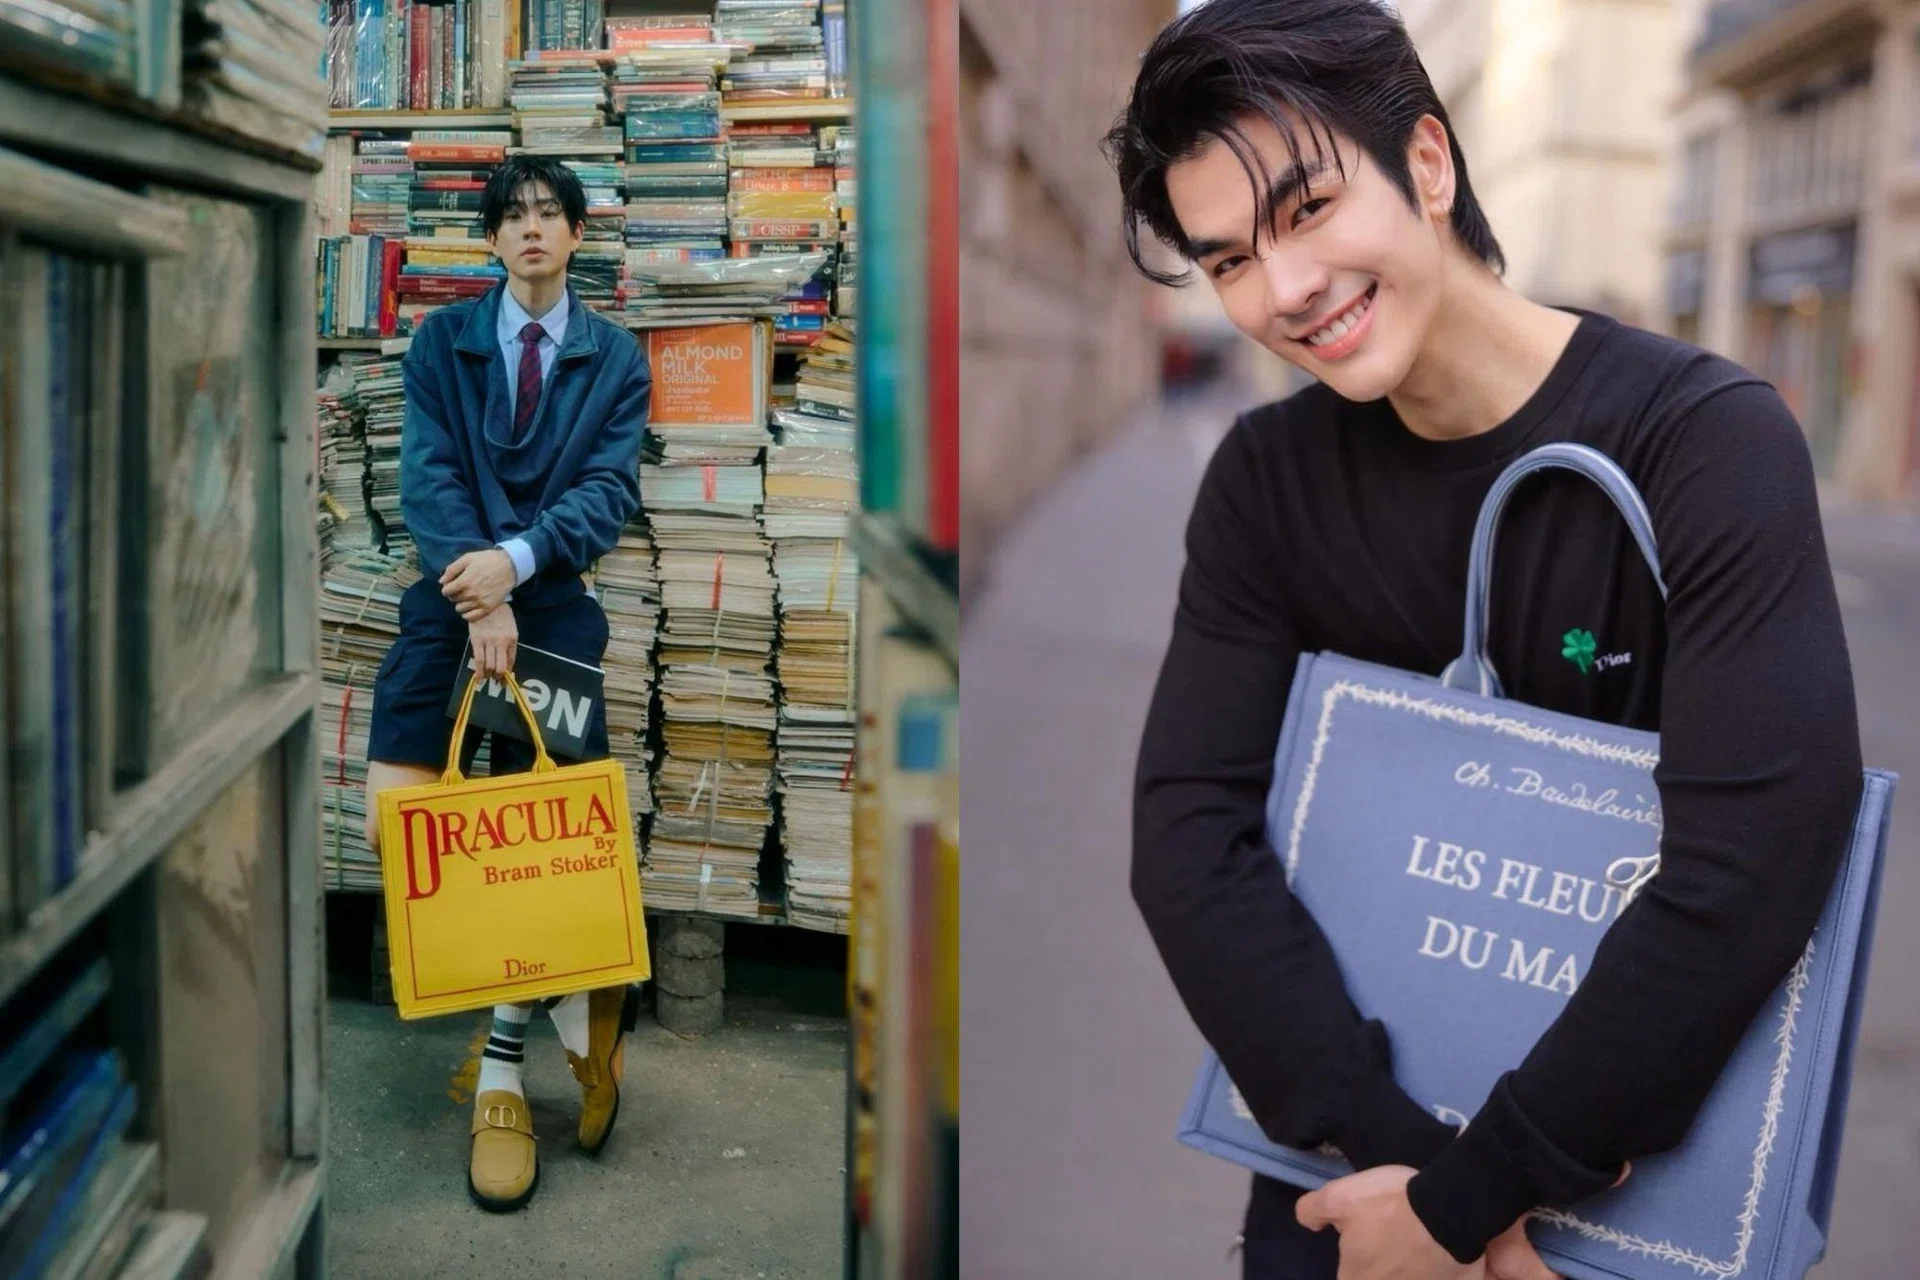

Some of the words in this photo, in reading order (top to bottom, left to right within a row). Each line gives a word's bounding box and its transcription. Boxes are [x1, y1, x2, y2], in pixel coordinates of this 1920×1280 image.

[661, 345, 743, 360] ALMOND
[661, 359, 707, 374] MILK
[661, 374, 720, 384] ORIGINAL
[399, 793, 618, 901] DRACULA
[594, 837, 617, 853] By
[483, 866, 542, 885] Bram
[551, 854, 619, 876] Stoker
[1406, 835, 1487, 891] LES
[1418, 916, 1498, 970] DU
[503, 959, 547, 979] Dior
